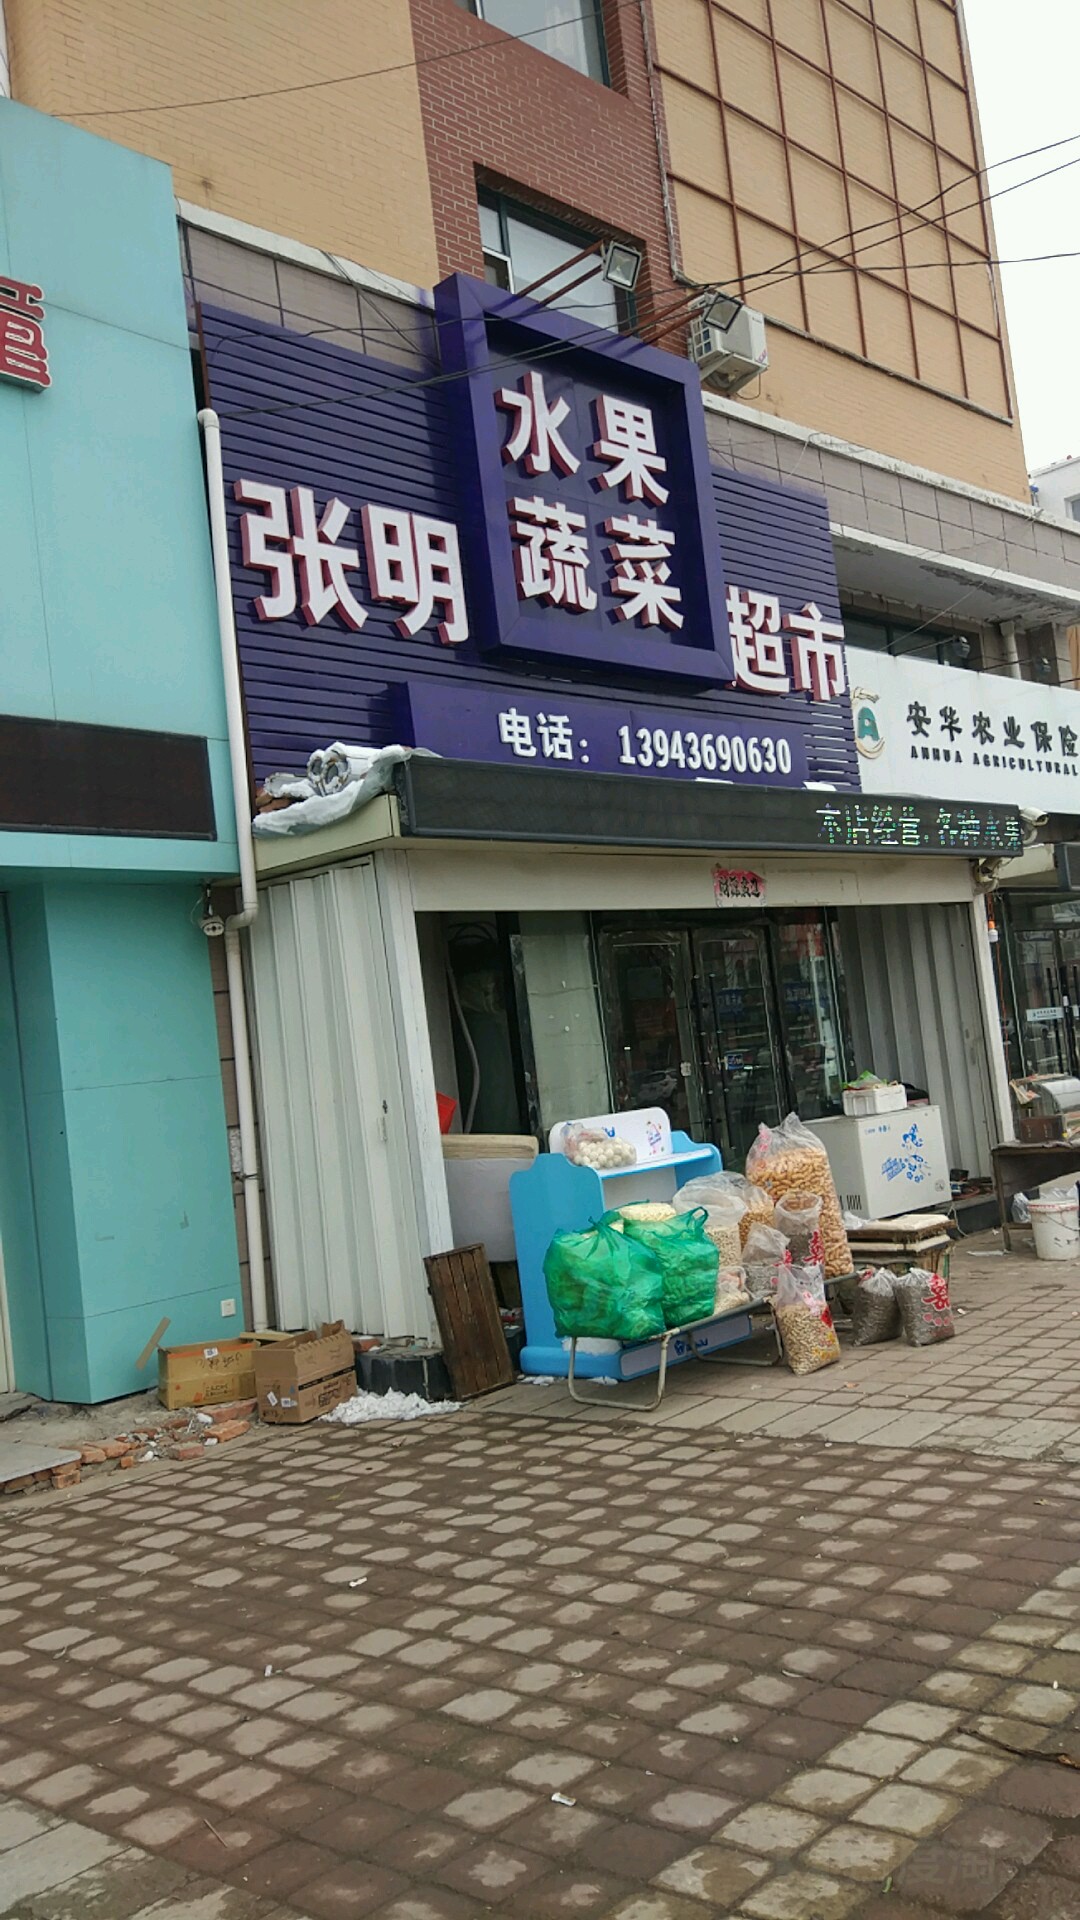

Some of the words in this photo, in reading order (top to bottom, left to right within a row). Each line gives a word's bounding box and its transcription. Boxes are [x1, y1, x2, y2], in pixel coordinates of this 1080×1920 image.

[497, 371, 669, 505] 水果
[234, 478, 470, 645] 张明
[509, 496, 684, 631] 蔬菜
[725, 584, 846, 700] 超市
[617, 724, 794, 776] 13943690630
[906, 701, 1079, 758] 安华农业保险
[972, 752, 1079, 777] AGRICULTURAL
